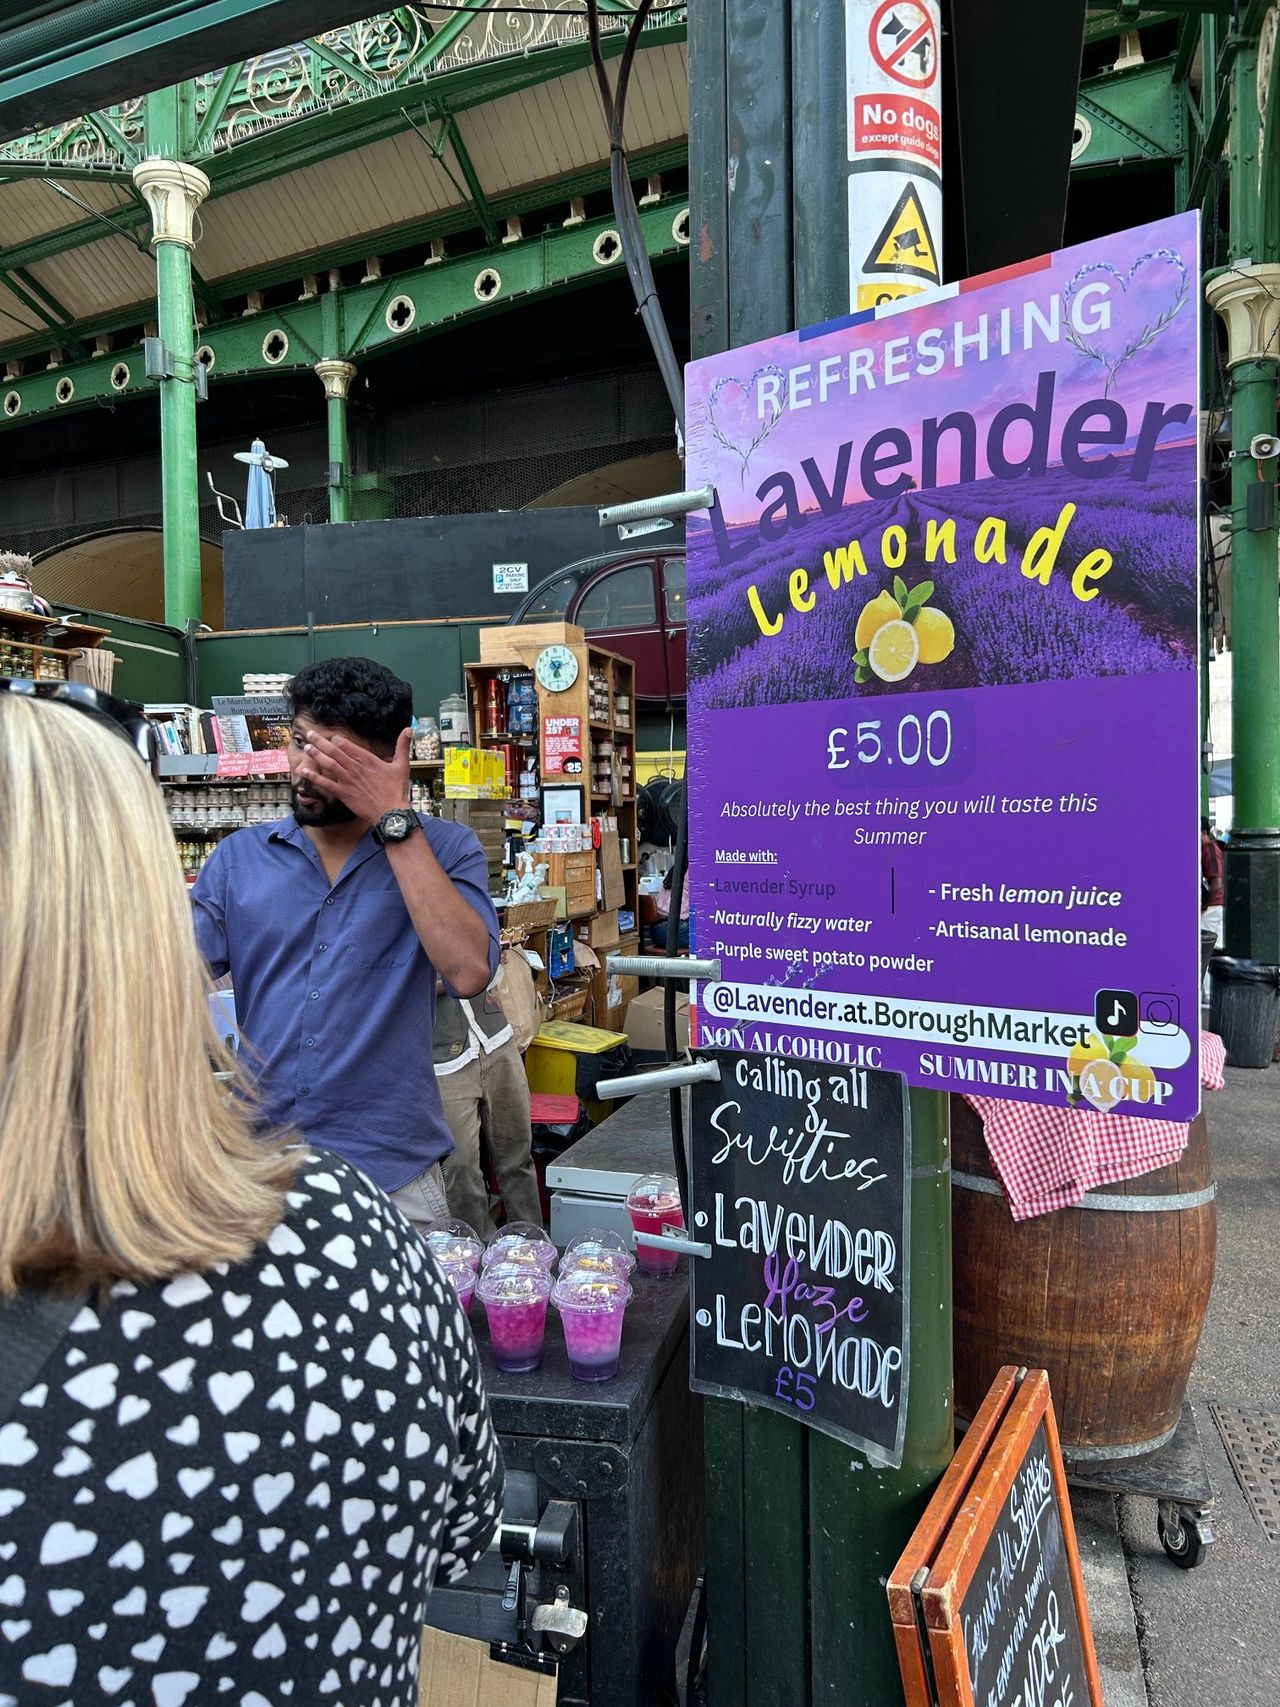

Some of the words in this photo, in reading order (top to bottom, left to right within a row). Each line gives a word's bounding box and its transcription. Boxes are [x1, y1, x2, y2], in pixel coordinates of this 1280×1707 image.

[863, 104, 896, 125] No
[901, 107, 939, 140] dogs
[862, 133, 898, 144] except
[900, 136, 924, 150] guide
[757, 282, 1111, 419] REFRESHING
[711, 371, 1194, 567] Lavender
[545, 726, 562, 734] 25?
[546, 718, 579, 727] UNDER
[827, 709, 952, 770] £5.00
[720, 801, 800, 820] Absolutely
[805, 800, 830, 816] the
[834, 799, 871, 815] best
[875, 797, 920, 819] thing
[922, 800, 958, 819] you
[964, 795, 995, 813] will
[1001, 796, 1053, 813] taste
[1059, 793, 1098, 812] this
[853, 828, 927, 845] Summer
[715, 850, 746, 862] Made
[749, 850, 778, 862] with:
[789, 879, 836, 900] Syrup
[941, 883, 993, 901] Fresh
[999, 884, 1063, 904] lemon
[1065, 885, 1121, 910] juice
[709, 910, 784, 931] -Naturally
[786, 913, 822, 933] fizzy
[825, 917, 872, 932] water
[929, 920, 1019, 941] -Artisanal
[1024, 924, 1127, 947] lemonade
[710, 941, 762, 961] -Purple
[765, 946, 809, 962] sweet
[812, 950, 865, 967] potato
[869, 954, 934, 971] powder
[713, 986, 1091, 1049] @Lavender.at.BoroughMarket
[701, 1025, 745, 1049] NON
[750, 1032, 882, 1068] ALCOHOLIC
[829, 1067, 868, 1109] all
[920, 1053, 1038, 1090] SUMMER
[1044, 1068, 1074, 1094] IN
[1082, 1073, 1103, 1098] A
[1109, 1076, 1173, 1106] CUP
[710, 1100, 887, 1191] Swifties
[764, 1250, 869, 1333] Haze
[775, 1366, 817, 1411] £5
